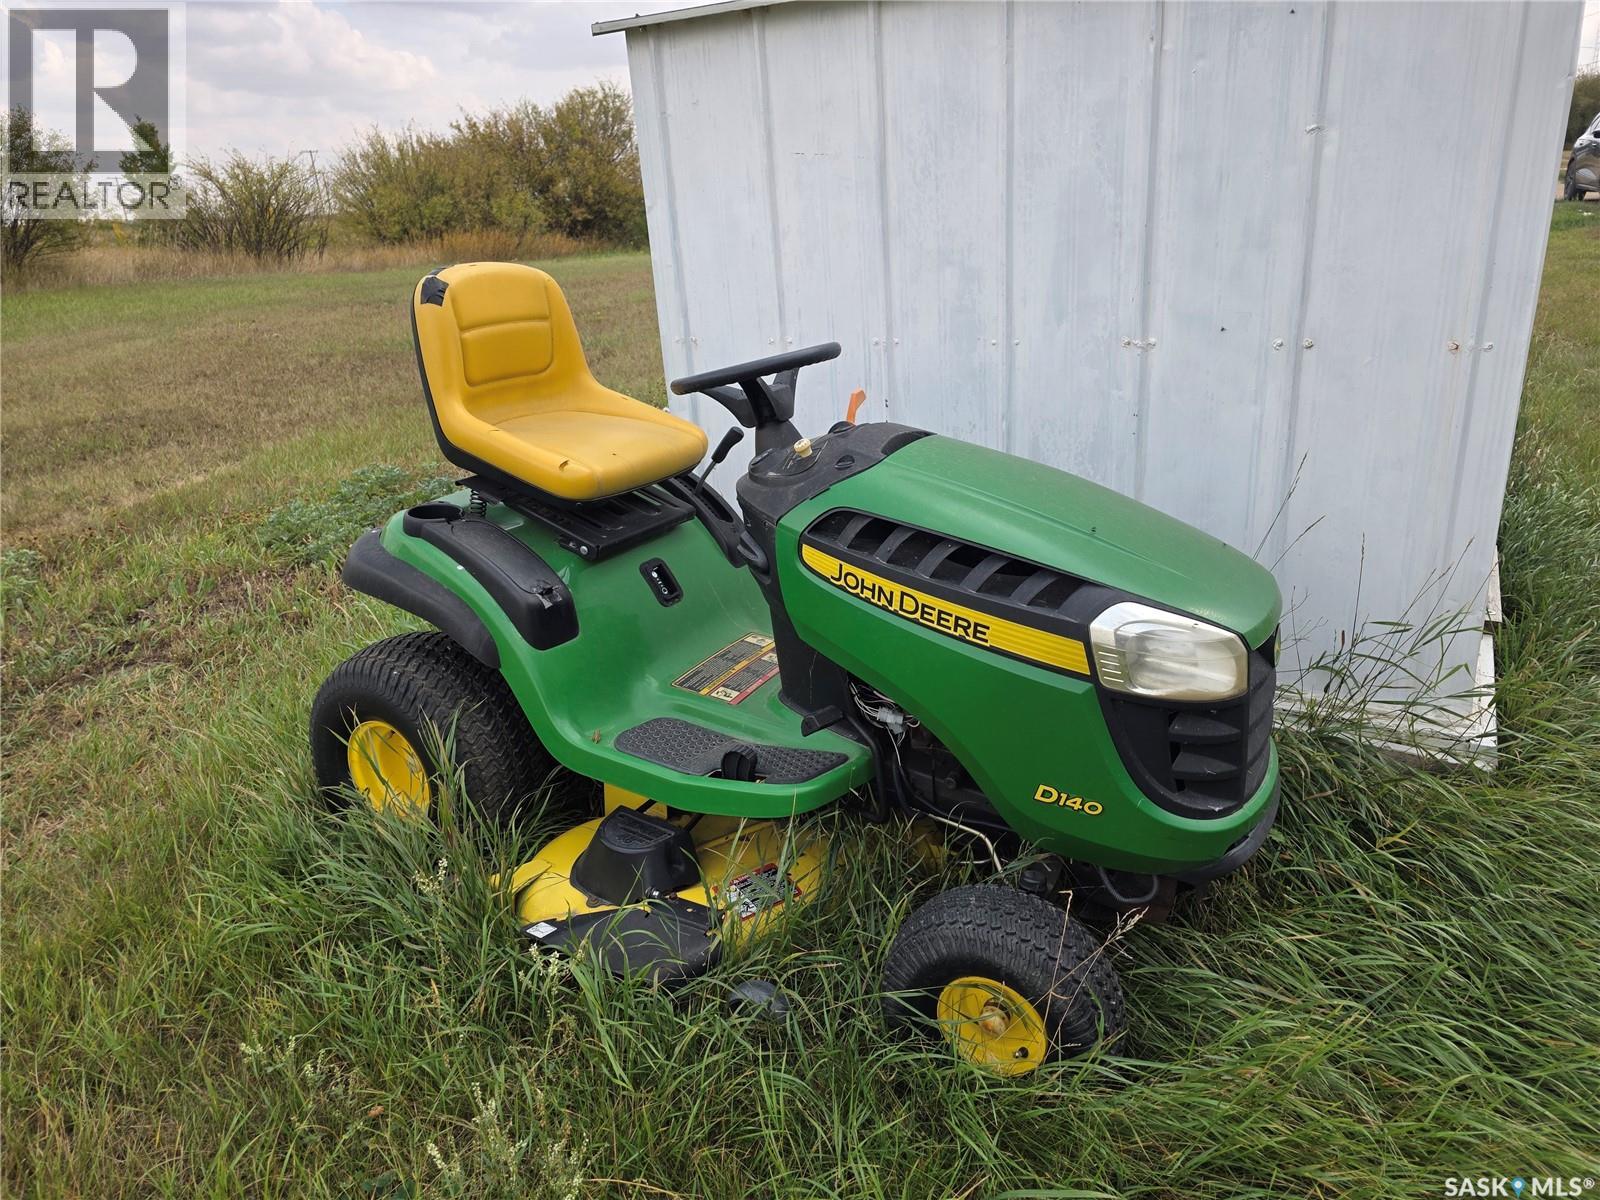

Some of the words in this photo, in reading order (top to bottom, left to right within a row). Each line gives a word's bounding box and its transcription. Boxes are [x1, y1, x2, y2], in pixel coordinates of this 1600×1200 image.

[830, 563, 895, 609] JOHN
[899, 591, 991, 643] DEERE
[1033, 783, 1104, 816] D140
